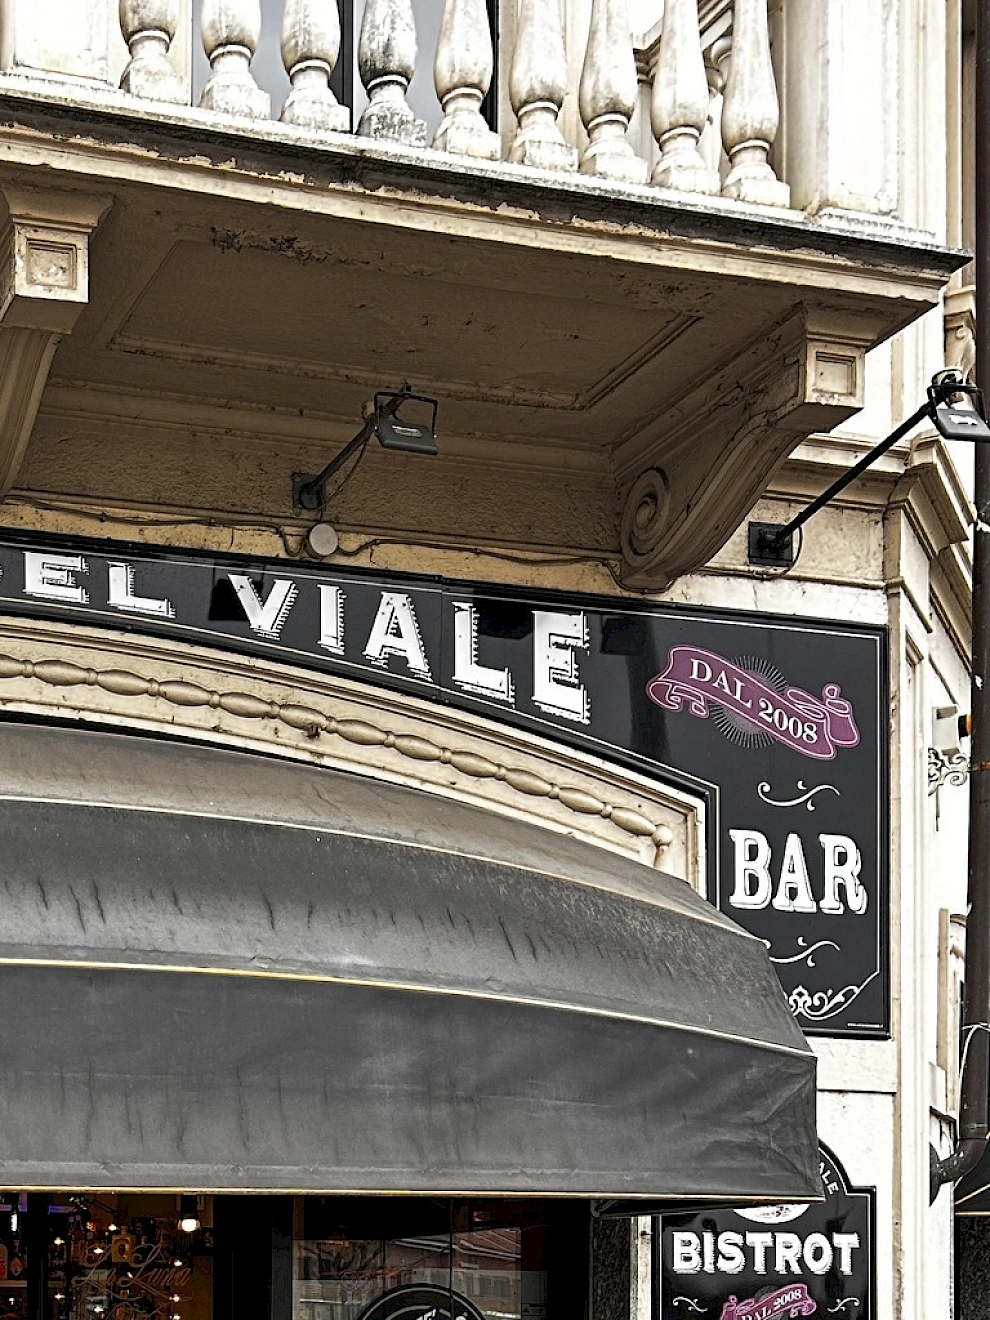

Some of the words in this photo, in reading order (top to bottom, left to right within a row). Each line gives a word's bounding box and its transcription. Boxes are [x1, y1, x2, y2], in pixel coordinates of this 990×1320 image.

[227, 572, 592, 725] VIALE
[689, 658, 753, 709] DAL
[758, 697, 817, 744] 2008
[727, 828, 868, 915] BAR
[671, 1231, 860, 1275] BISTROT
[773, 1289, 803, 1311] 2008
